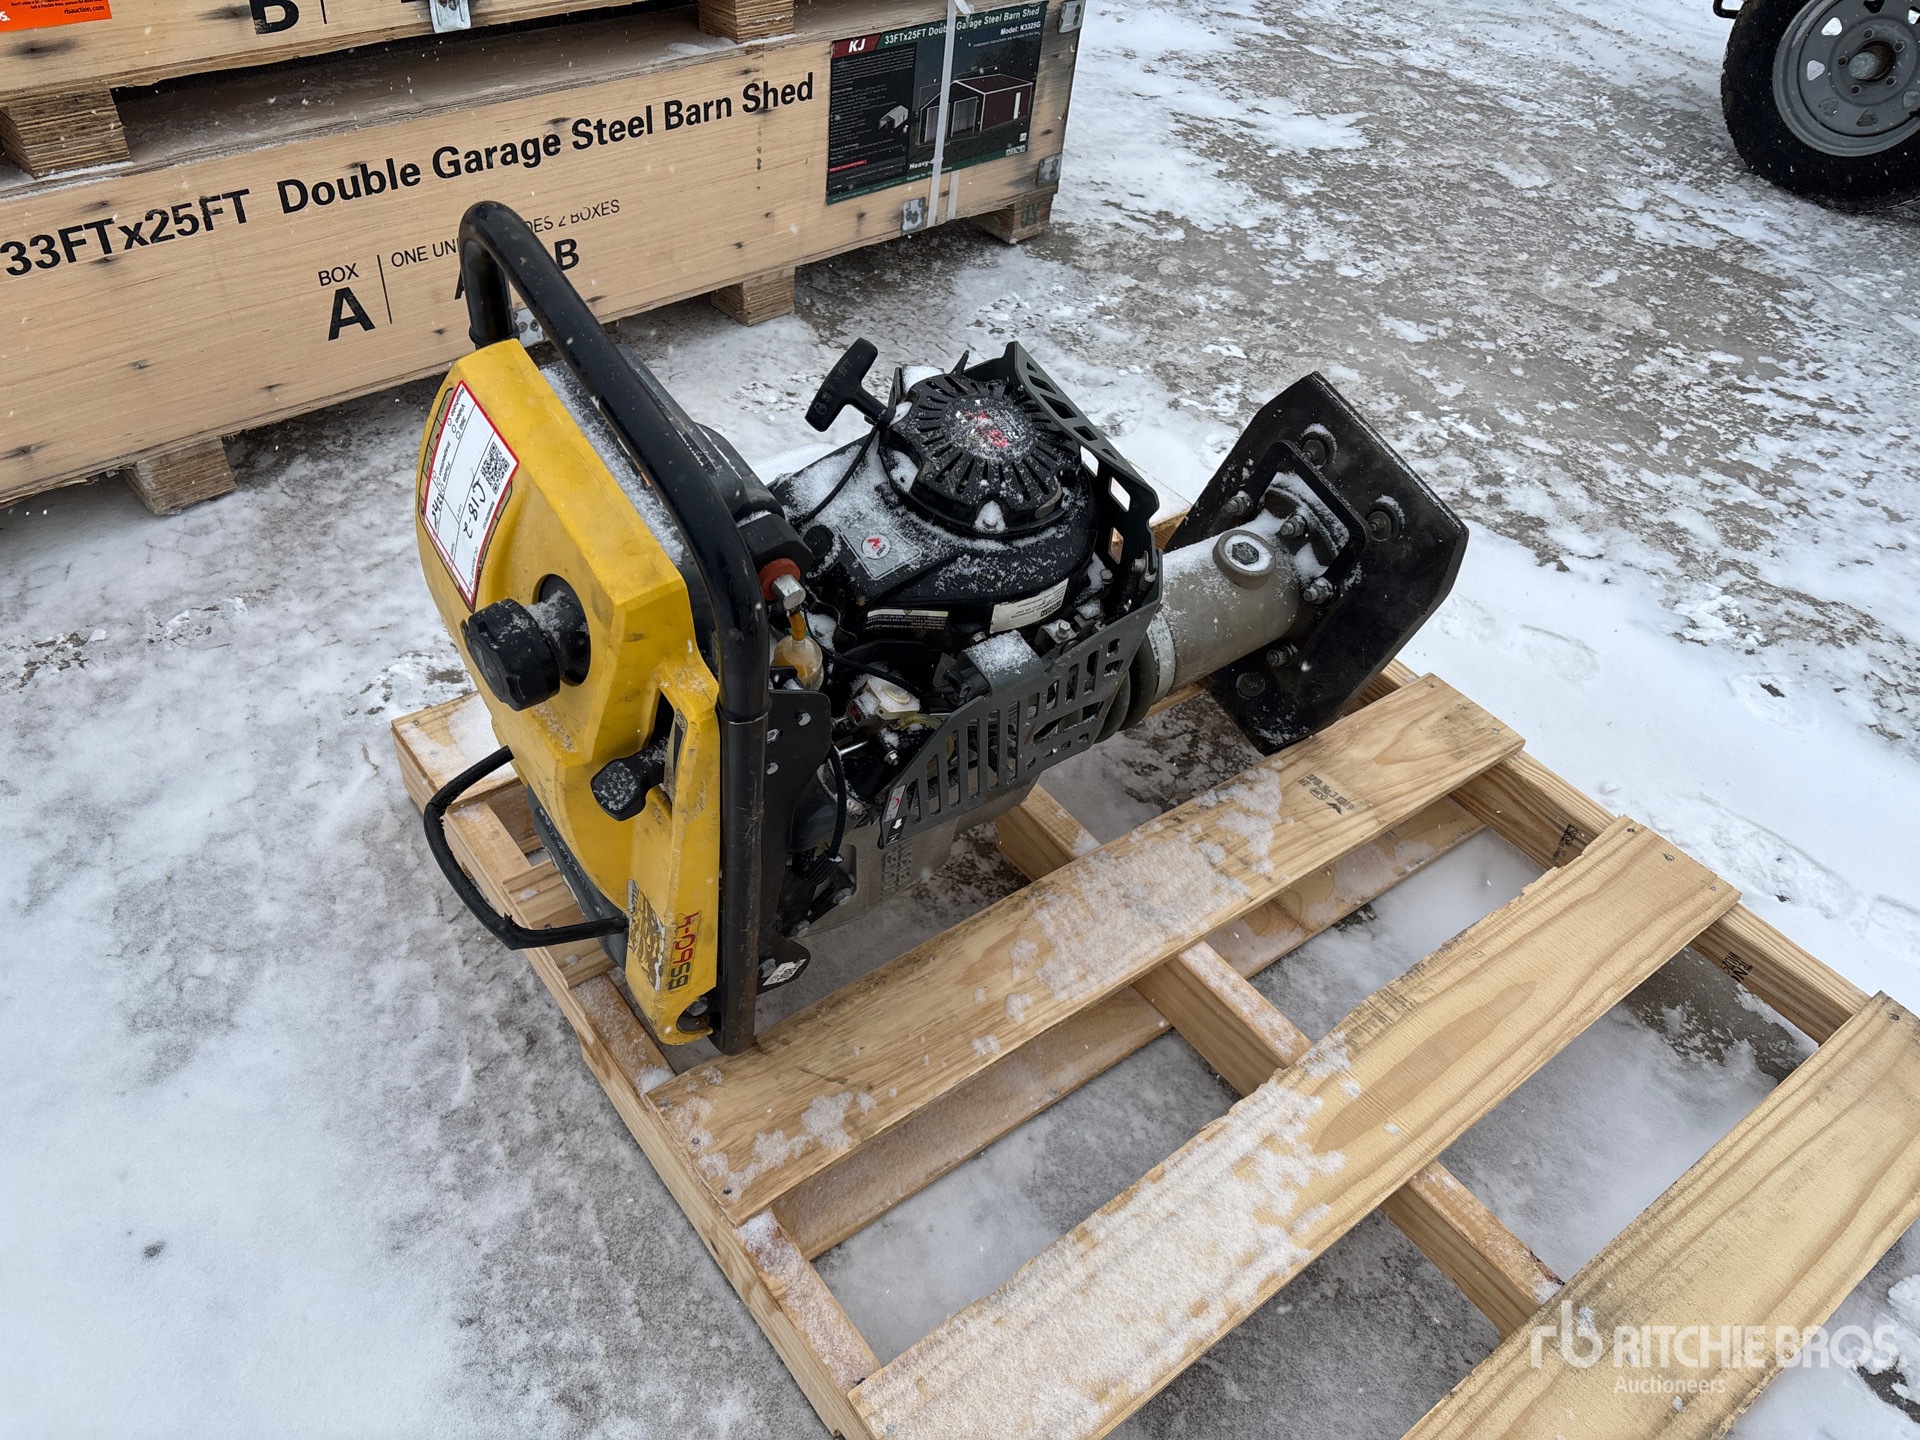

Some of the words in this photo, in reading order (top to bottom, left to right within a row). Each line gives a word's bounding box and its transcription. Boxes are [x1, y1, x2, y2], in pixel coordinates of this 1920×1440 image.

[64, 5, 105, 14] rbauction.com
[884, 29, 927, 45] 33FTx25FT
[928, 24, 948, 37] Doub
[983, 14, 1002, 25] Steel
[1003, 12, 1021, 21] Barn
[1022, 7, 1040, 17] Shed
[848, 39, 866, 53] KJ
[1000, 26, 1019, 36] Model:
[0, 188, 250, 276] 33FTx25FT
[277, 157, 421, 215] Double
[432, 126, 561, 179] Garage
[571, 107, 654, 150] Steel
[664, 88, 732, 130] Barn
[742, 72, 814, 116] Shed
[391, 246, 428, 267] ONE
[432, 237, 460, 257] UNI
[570, 199, 620, 223] BOXES
[555, 238, 580, 271] B
[318, 263, 359, 287] BOX
[327, 286, 375, 341] A
